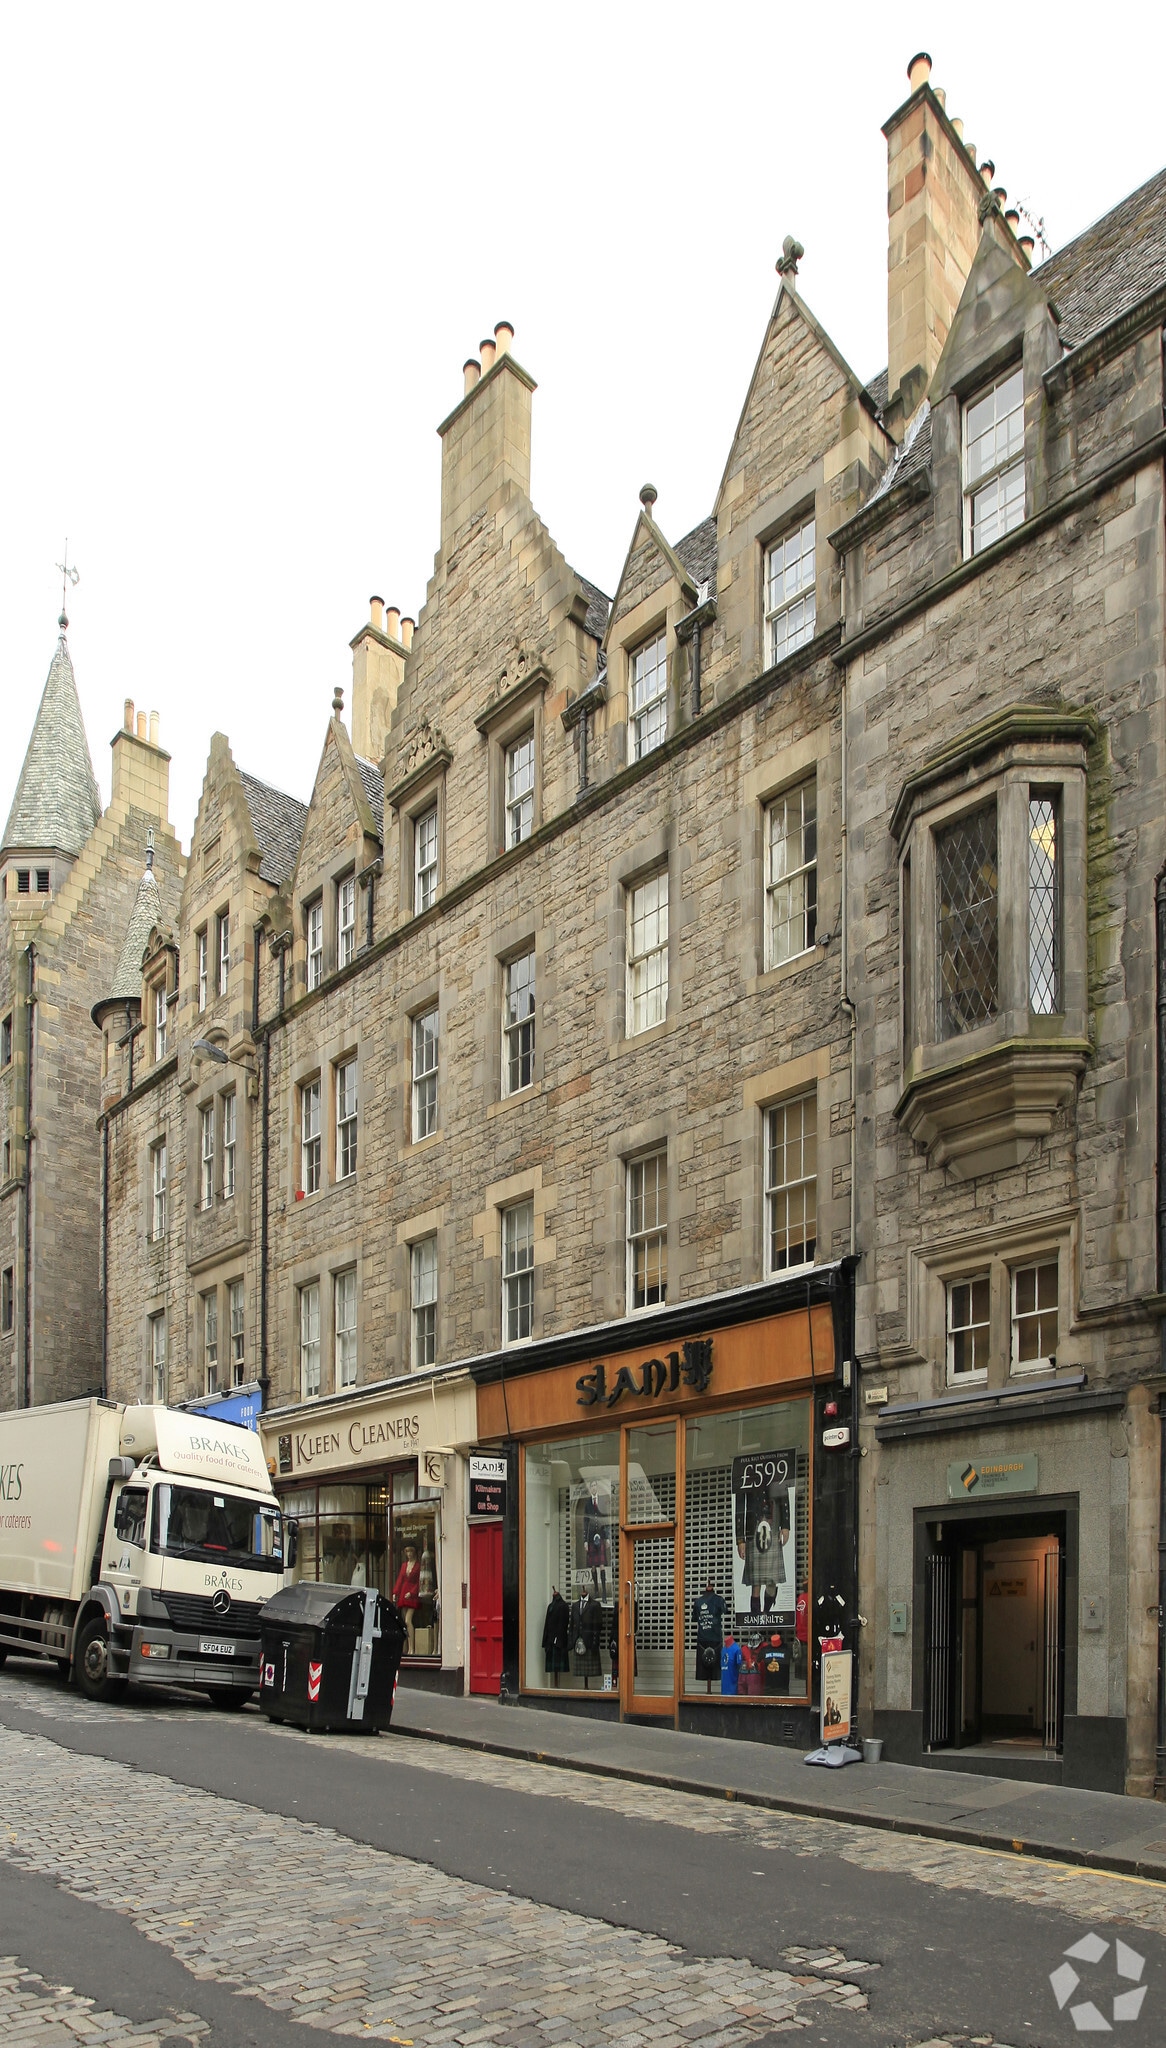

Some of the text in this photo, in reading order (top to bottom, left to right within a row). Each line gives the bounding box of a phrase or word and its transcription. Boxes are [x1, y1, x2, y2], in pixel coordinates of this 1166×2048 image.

[240, 1406, 254, 1418] FOOD
[189, 1436, 250, 1463] BRAKES
[296, 1415, 420, 1464] KLEEN CLEANERS
[173, 1450, 264, 1479] Quality food for caterers
[424, 1455, 441, 1482] KC
[740, 1459, 788, 1489] £599
[981, 1463, 1025, 1474] EDINBURGH
[0, 1463, 24, 1501] KES
[487, 1502, 499, 1512] Shop
[5, 1514, 31, 1529] caterers
[204, 1574, 243, 1591] BRAKES
[203, 1643, 233, 1654] SF04 EUZ
